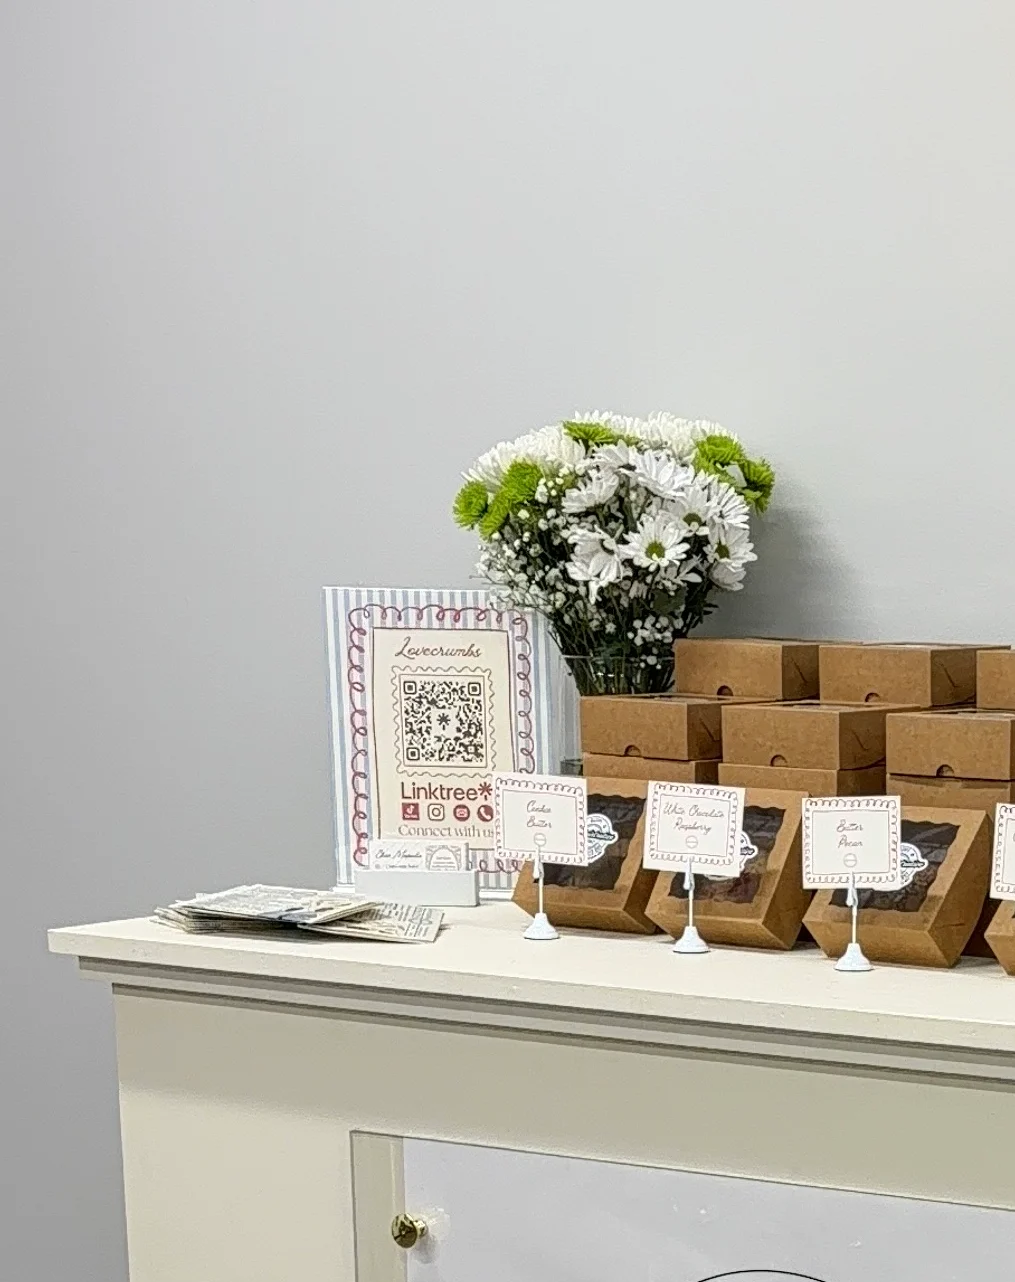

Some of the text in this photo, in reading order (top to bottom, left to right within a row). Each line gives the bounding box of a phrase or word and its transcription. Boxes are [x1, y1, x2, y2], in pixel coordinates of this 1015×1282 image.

[395, 636, 482, 660] Lovecrumbs
[401, 782, 479, 801] Linktree
[398, 824, 452, 837] Connect
[454, 825, 481, 837] with
